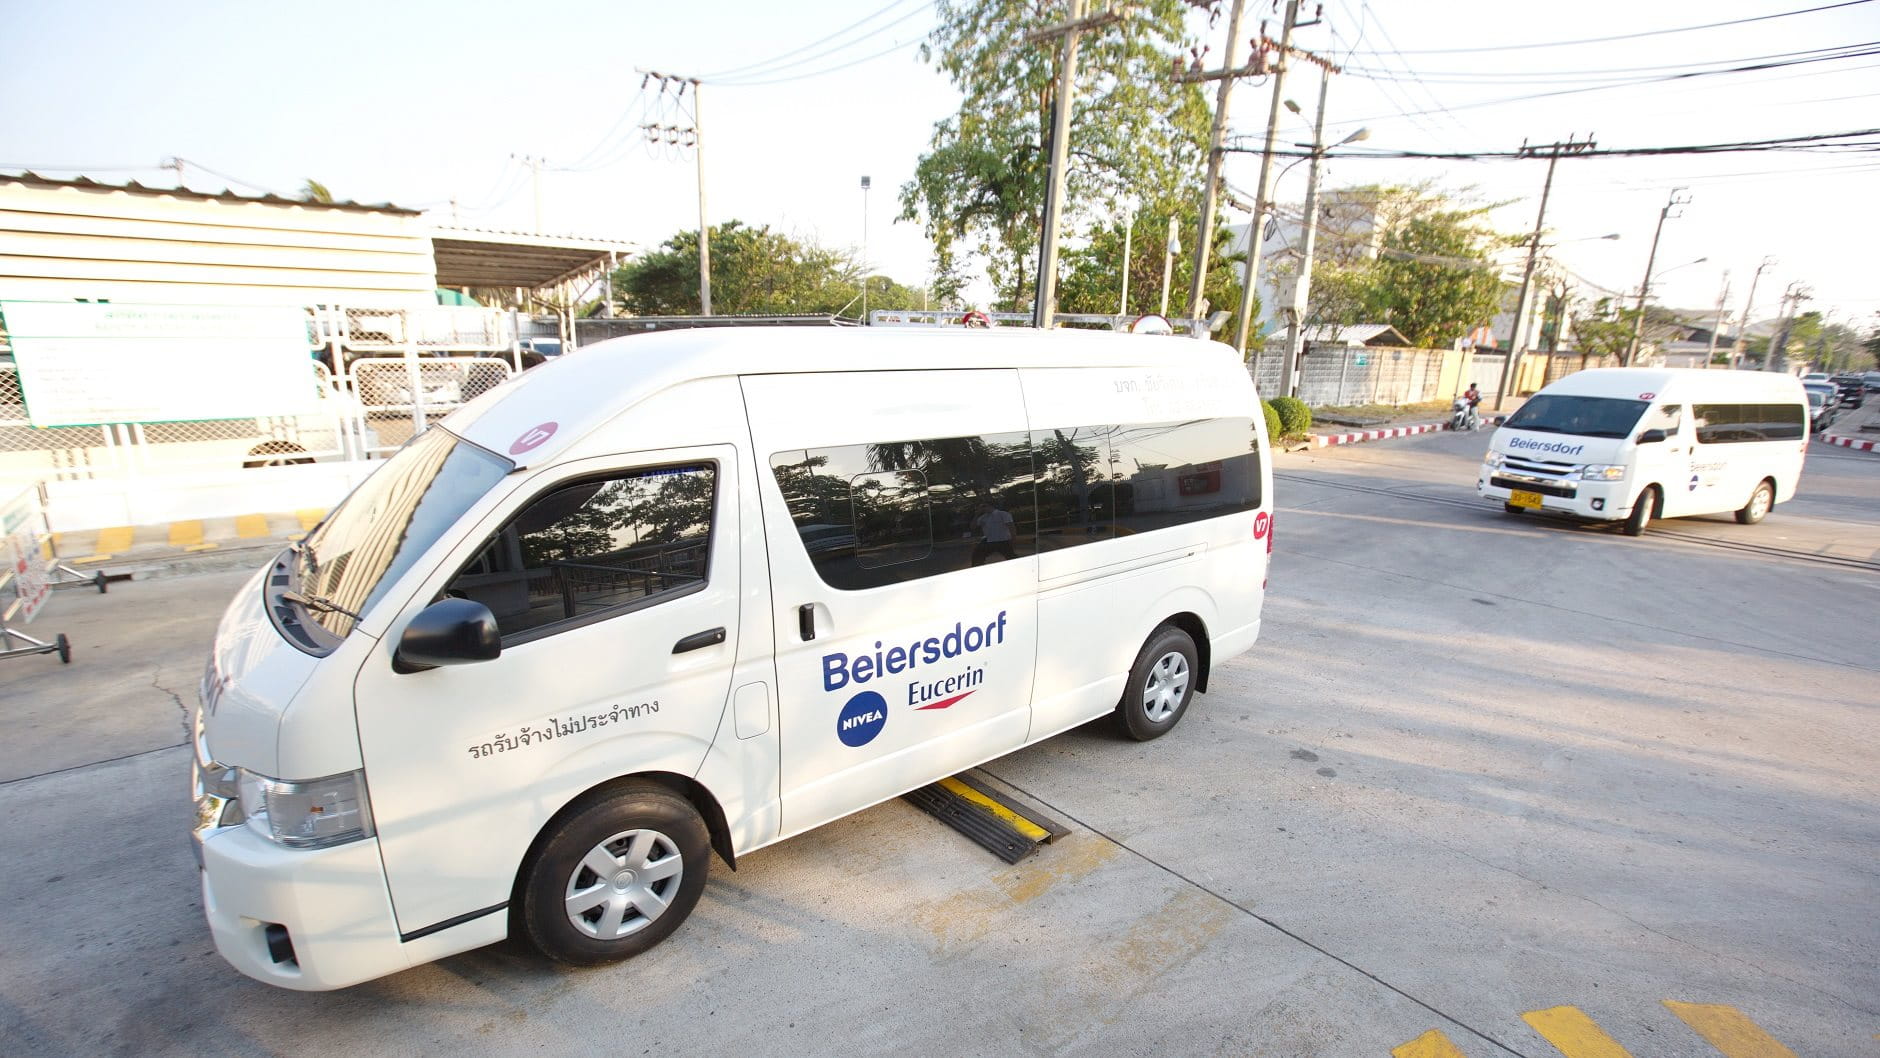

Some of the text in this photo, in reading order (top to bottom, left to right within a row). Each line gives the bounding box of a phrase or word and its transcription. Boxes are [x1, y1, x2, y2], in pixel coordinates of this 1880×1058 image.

[1509, 437, 1584, 455] Beiersdorf
[1256, 518, 1267, 533] V7
[822, 610, 1007, 692] Beiersdorf
[908, 665, 984, 706] Eucerin
[468, 700, 660, 759] รถรับจ้างไม่ประจำทาง
[842, 709, 883, 731] NIVEA
